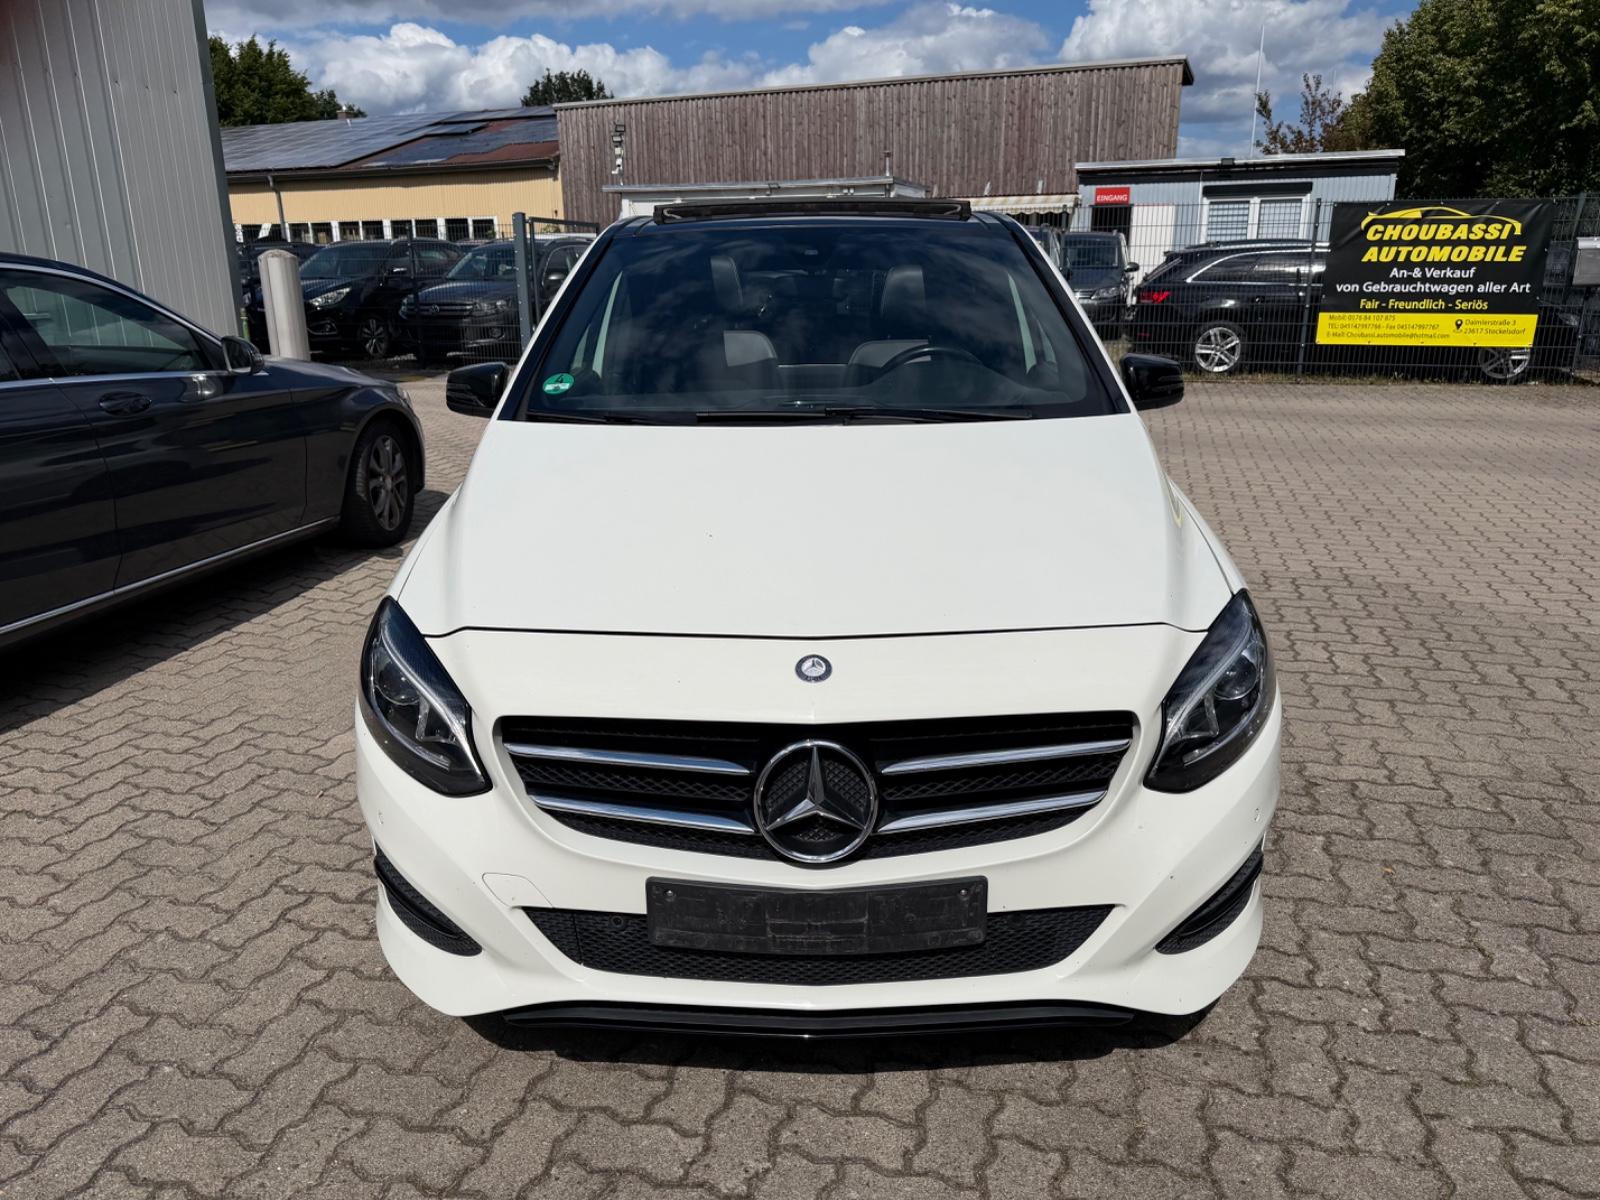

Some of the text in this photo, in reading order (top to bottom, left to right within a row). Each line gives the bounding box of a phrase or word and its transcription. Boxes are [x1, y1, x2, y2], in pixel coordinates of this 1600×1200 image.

[1096, 194, 1128, 202] EINGANG
[1366, 223, 1513, 240] CHOUBASSI
[1361, 245, 1527, 262] AUTOMOBILE
[1389, 267, 1477, 279] An-& Verkauf
[1336, 281, 1531, 295] von Gebrauchtwagen aller Art
[1359, 299, 1379, 309] Fair
[1388, 299, 1445, 310] Freundlich
[1455, 299, 1489, 310] Seriös
